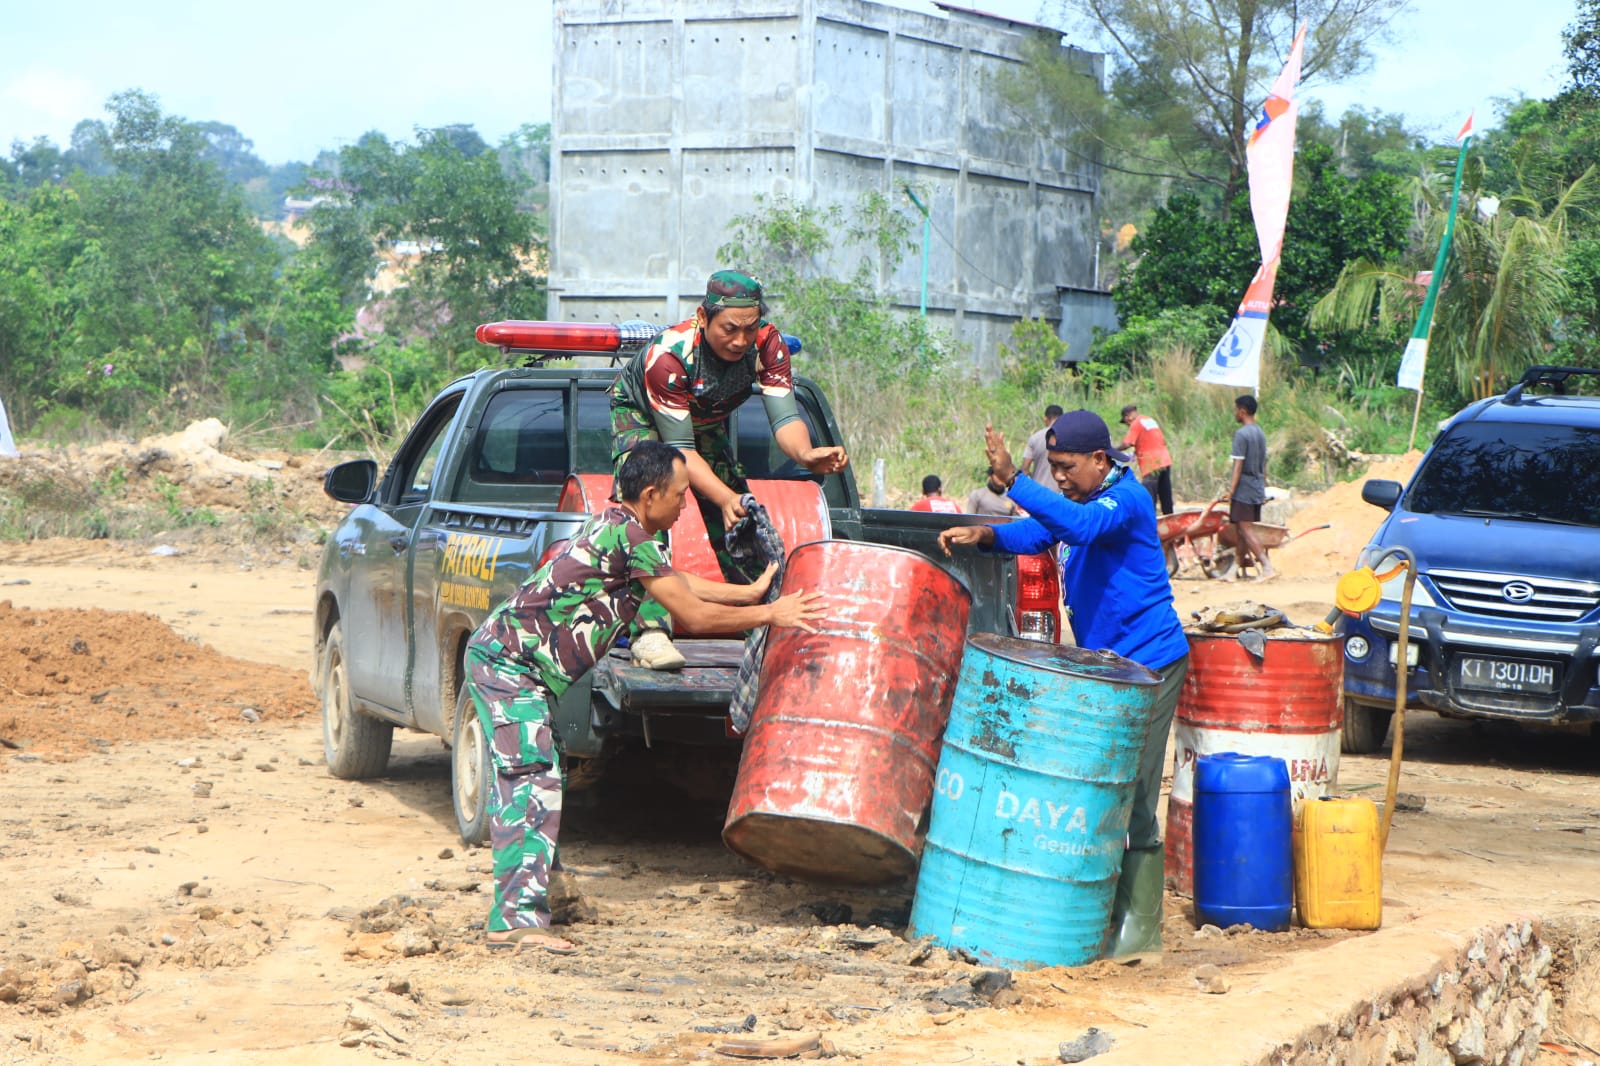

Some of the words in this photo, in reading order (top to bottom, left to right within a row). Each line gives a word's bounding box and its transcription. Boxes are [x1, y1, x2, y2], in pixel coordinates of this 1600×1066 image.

[441, 532, 503, 582] PATROLI
[1461, 658, 1485, 678] KT
[995, 790, 1088, 834] DAYA
